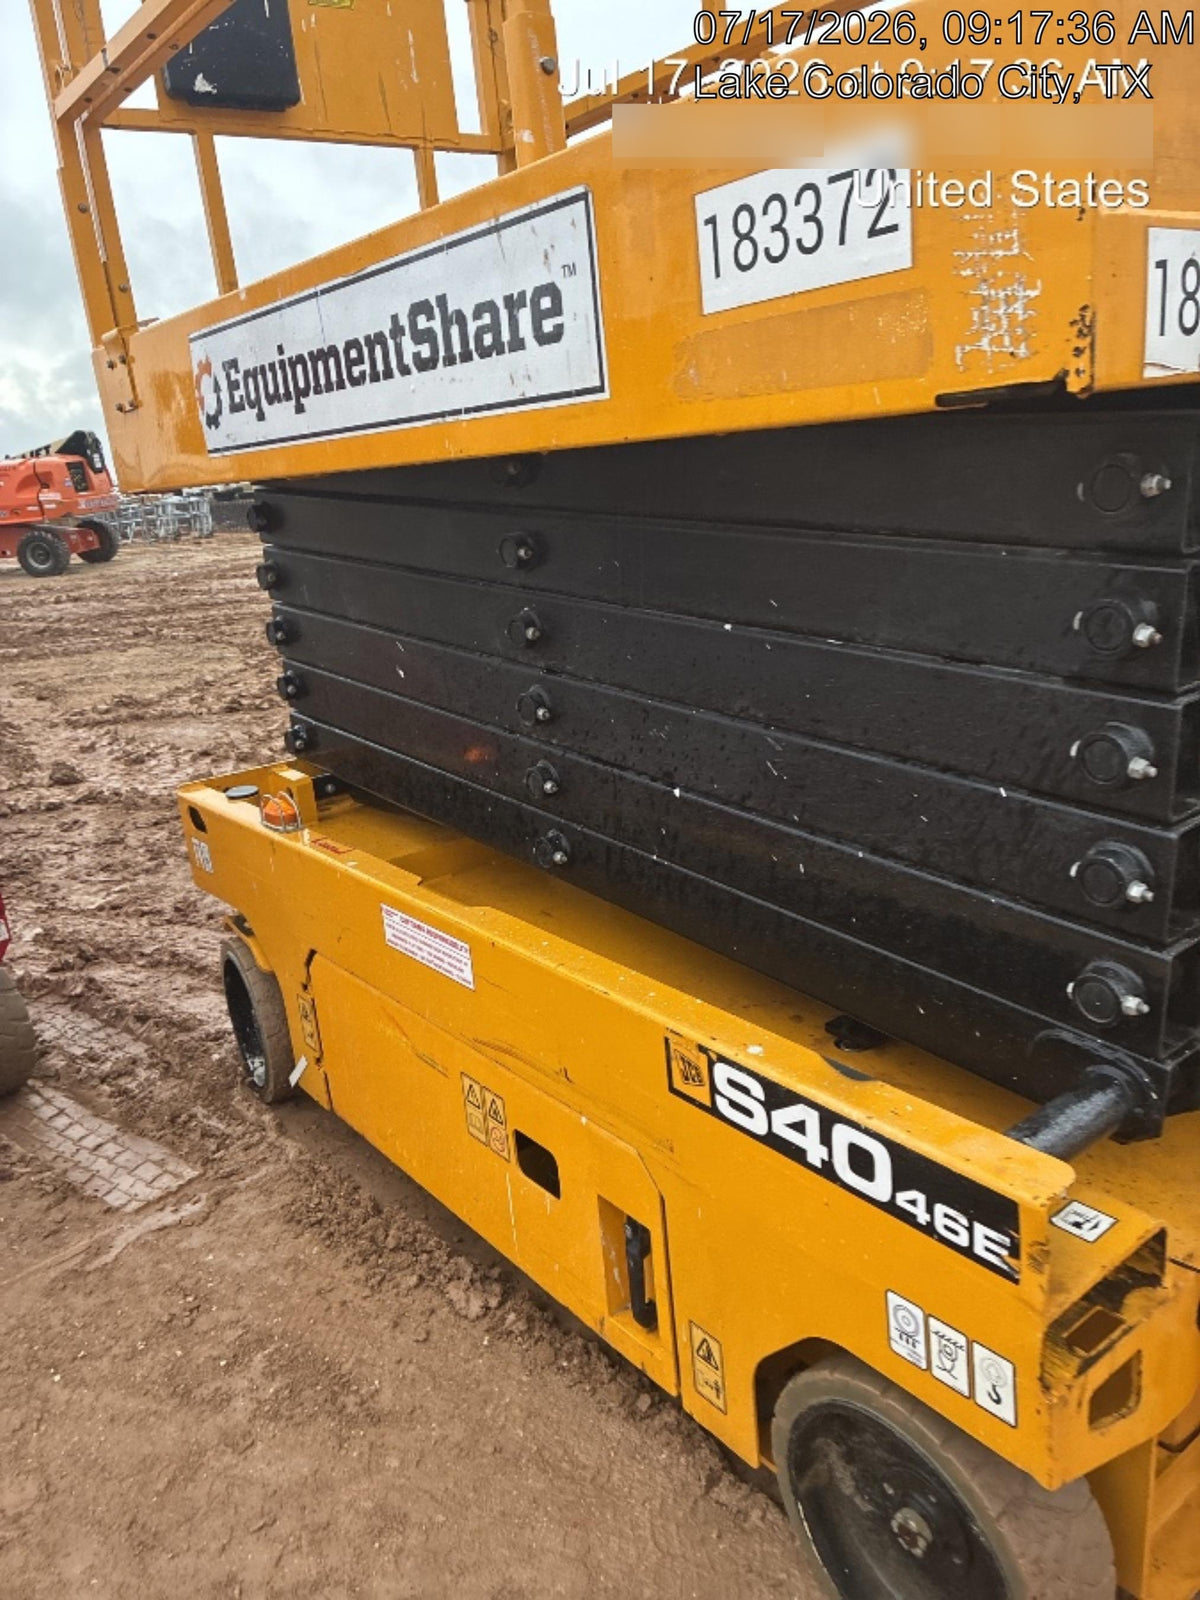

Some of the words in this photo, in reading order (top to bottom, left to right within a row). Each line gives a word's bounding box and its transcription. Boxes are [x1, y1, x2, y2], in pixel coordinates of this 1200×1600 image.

[704, 168, 899, 279] 183372
[221, 281, 565, 422] EquipmentShare
[1154, 257, 1200, 337] 18
